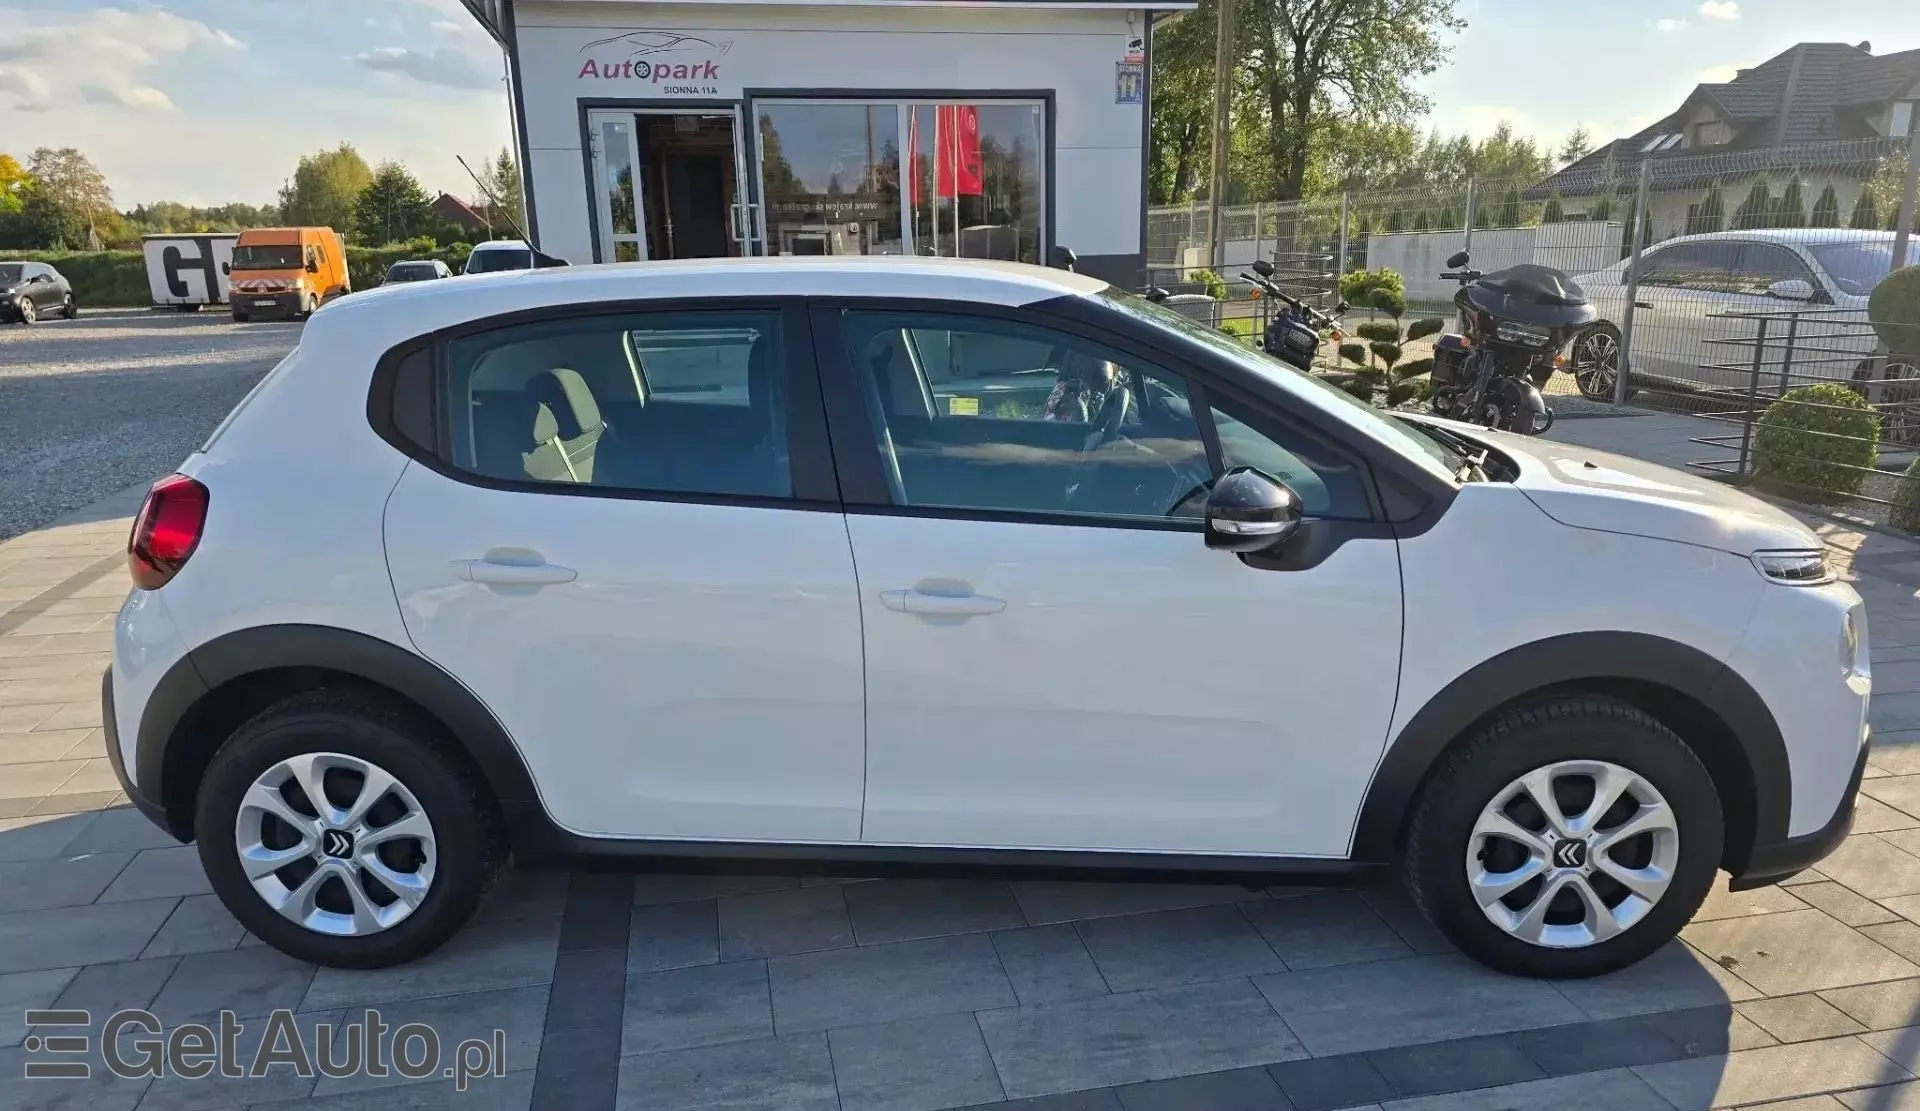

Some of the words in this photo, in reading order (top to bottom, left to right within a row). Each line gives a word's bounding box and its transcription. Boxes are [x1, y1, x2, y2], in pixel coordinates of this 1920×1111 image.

[578, 58, 720, 83] Autopark
[663, 86, 700, 94] SIONNA
[701, 86, 718, 94] 11A
